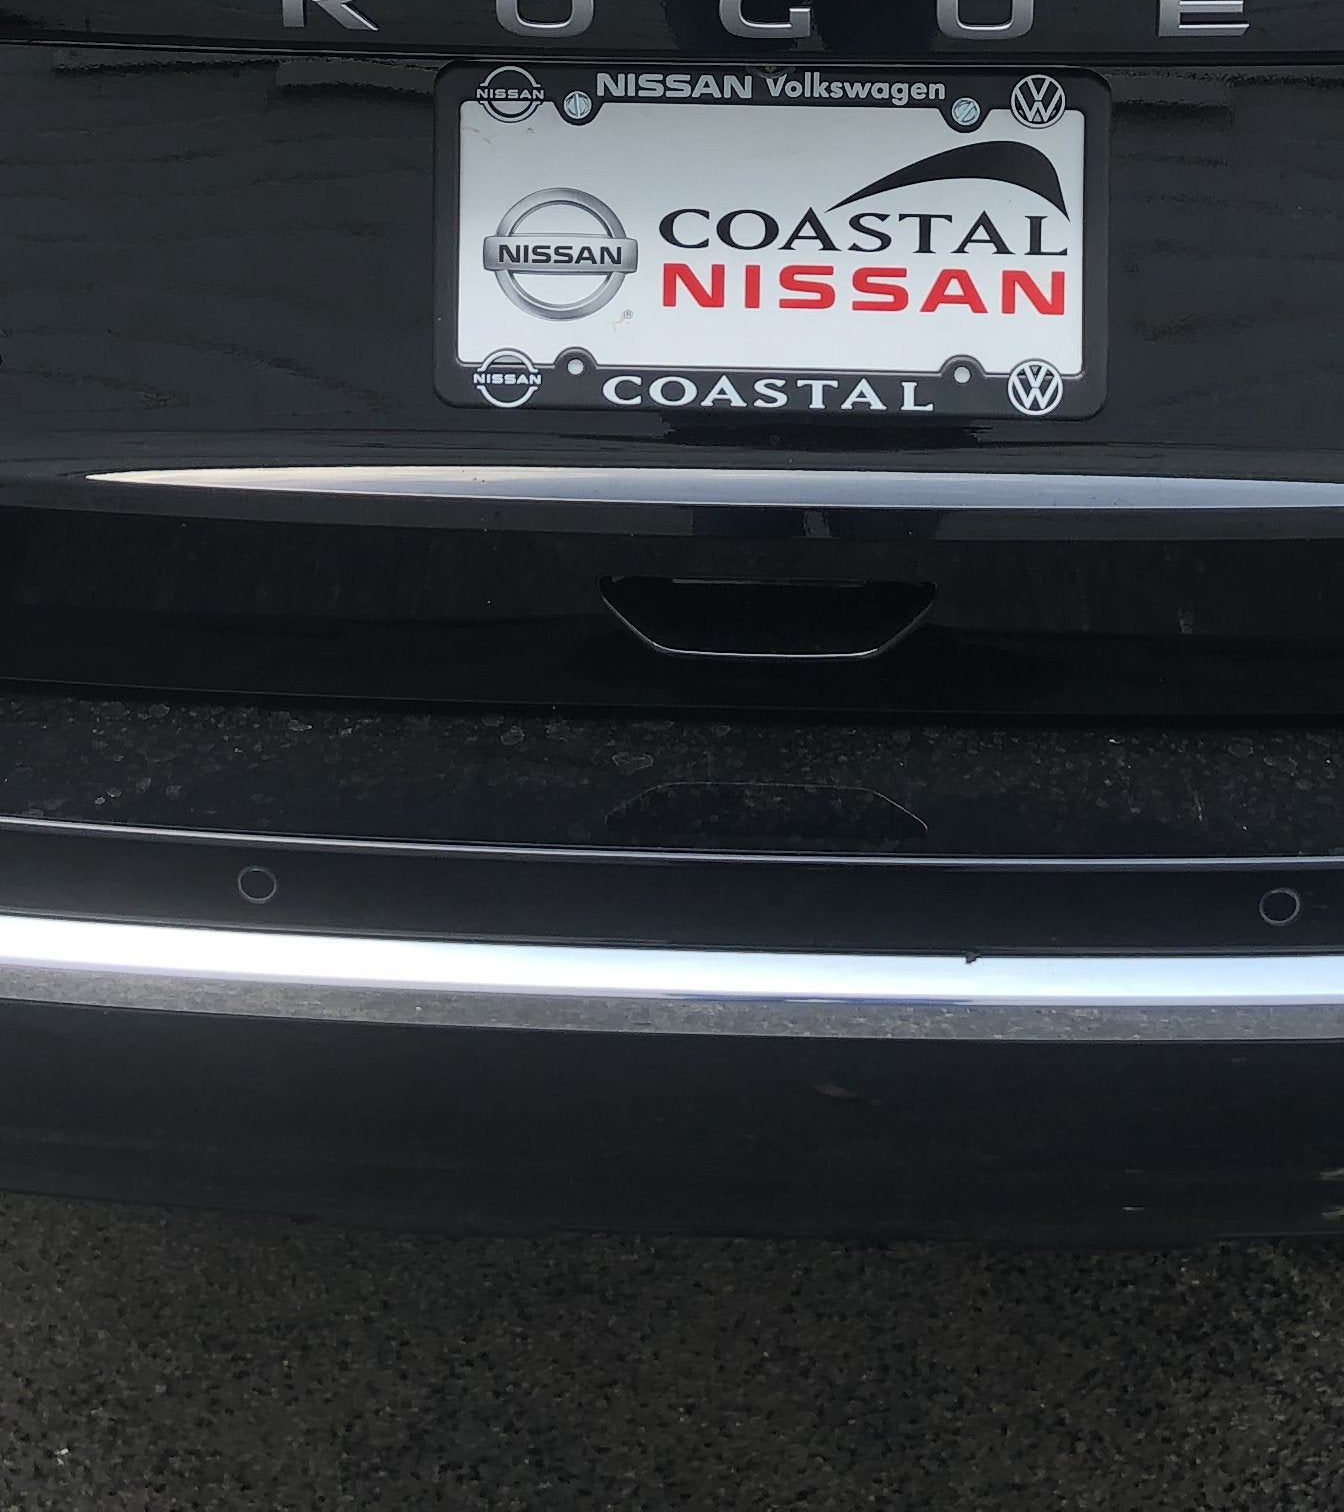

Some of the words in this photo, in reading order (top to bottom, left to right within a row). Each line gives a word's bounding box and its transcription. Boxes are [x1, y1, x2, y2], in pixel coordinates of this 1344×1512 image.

[476, 89, 544, 99] NISSAN
[596, 72, 753, 99] NISSAN
[765, 71, 946, 106] Volkswagen
[658, 207, 1069, 257] COASTAL
[498, 243, 623, 266] NISSAN
[662, 262, 1066, 316] NISSAN
[473, 373, 542, 385] NISSAN
[602, 375, 935, 412] COASTAL
